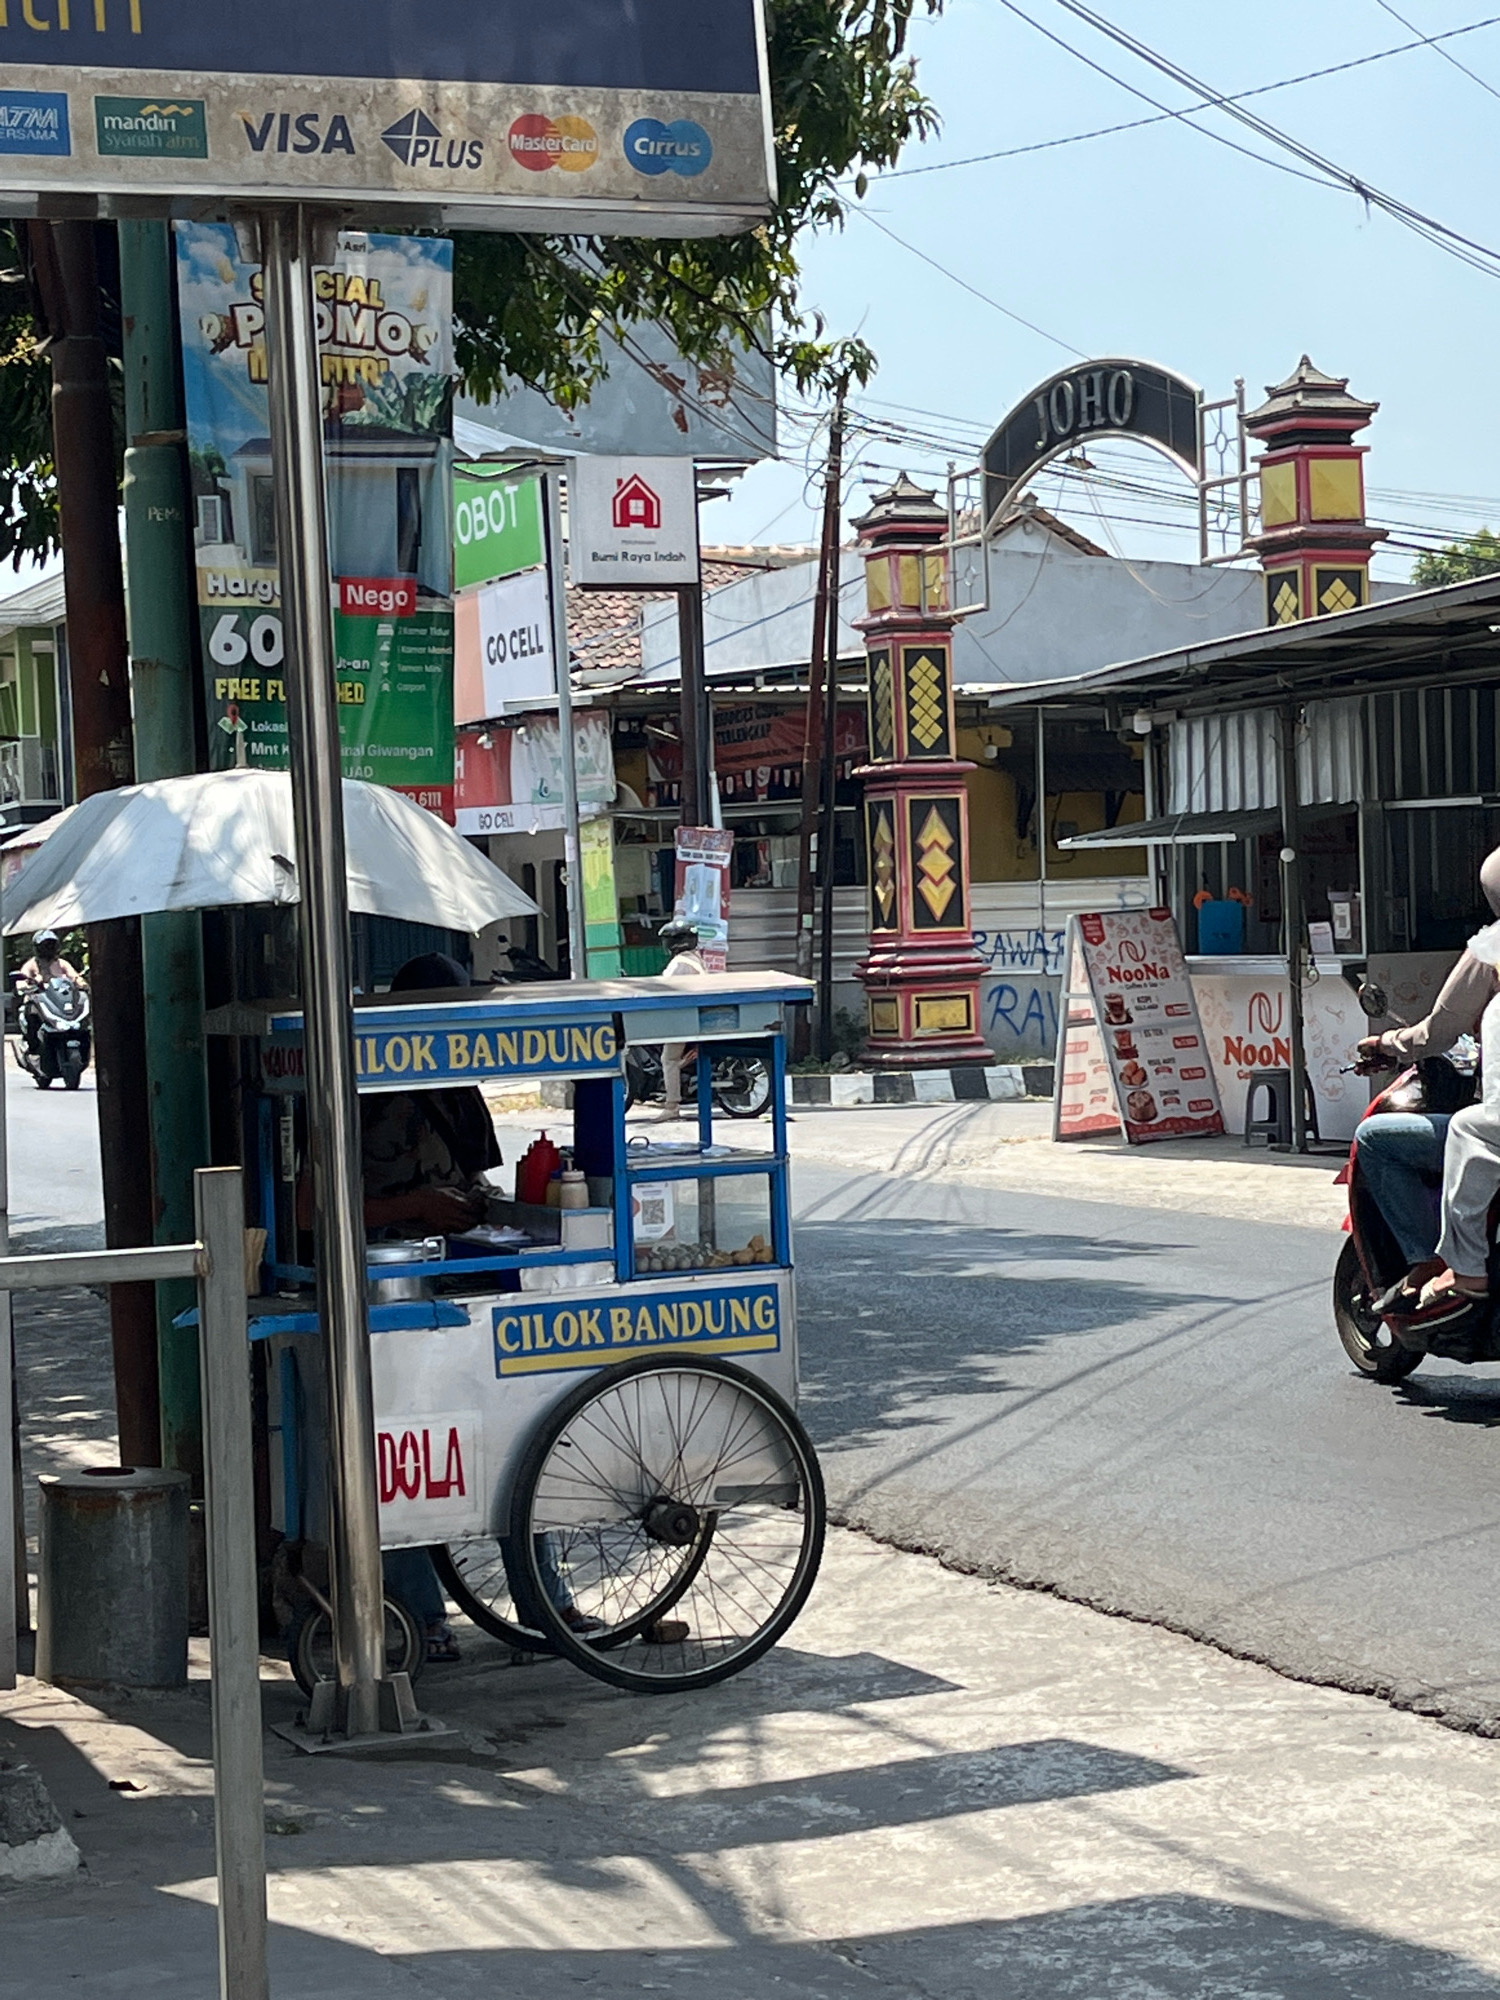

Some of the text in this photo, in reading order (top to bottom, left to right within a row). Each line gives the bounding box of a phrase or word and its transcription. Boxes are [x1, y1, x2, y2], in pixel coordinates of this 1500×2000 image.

[0, 128, 58, 140] ERSAMA
[104, 113, 176, 131] mandiri
[238, 111, 356, 155] VISA
[106, 133, 199, 149] syariah atm
[510, 133, 597, 152] MasterCard
[634, 137, 701, 157] Cirrus
[411, 139, 484, 169] PLUS
[249, 270, 385, 310] SCIAL
[230, 302, 412, 355] POMO
[1033, 370, 1132, 451] JOHO
[592, 551, 686, 563] Bumi Raya Indah
[347, 585, 408, 611] Nego
[487, 624, 544, 665] GO CELL
[215, 678, 260, 700] FREE
[368, 744, 434, 760] Giwangan
[344, 765, 374, 779] UAD
[1106, 962, 1170, 983] NooNa
[355, 1025, 616, 1075] ILOK BANDUNG
[1223, 1036, 1291, 1066] NooN
[497, 1296, 776, 1352] CILOK BANDUNG
